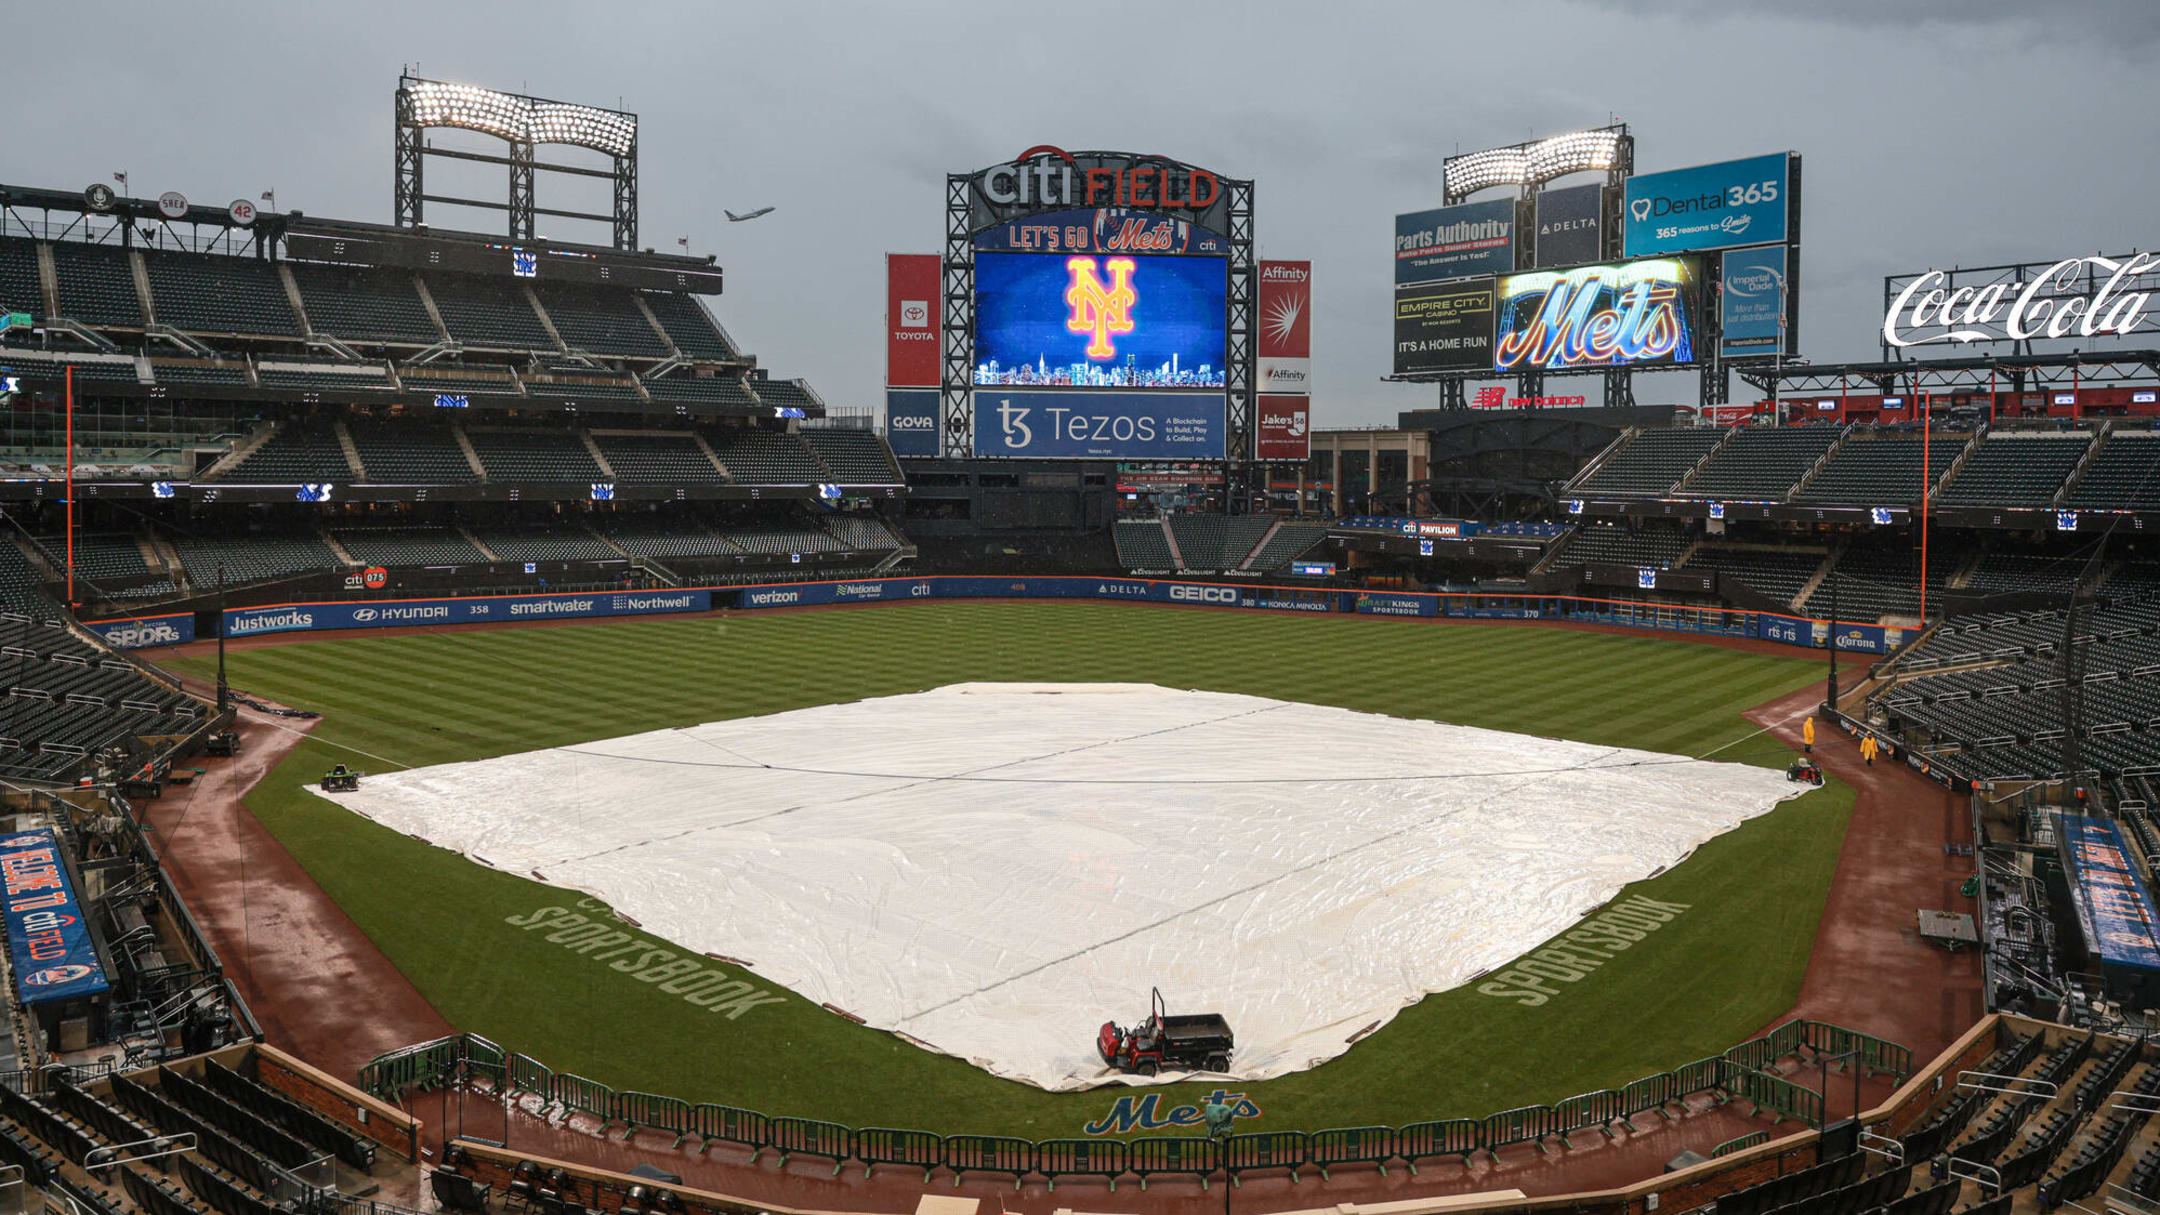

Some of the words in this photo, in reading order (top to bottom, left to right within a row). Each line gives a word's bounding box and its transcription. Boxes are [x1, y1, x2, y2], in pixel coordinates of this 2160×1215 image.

[984, 157, 1072, 206] citi
[1086, 167, 1219, 207] FIELD
[162, 200, 185, 209] SHEA
[234, 206, 251, 218] 42
[1553, 218, 1597, 233] DELTA
[1656, 227, 1677, 239] 365
[1679, 224, 1709, 234] reasons
[1010, 225, 1059, 248] LET'S
[1065, 226, 1088, 248] GO
[1107, 217, 1172, 249] Mets
[1396, 230, 1433, 251] Parts
[1436, 219, 1509, 245] Authority
[1199, 241, 1216, 250] citi
[1429, 255, 1459, 265] Answer
[1262, 266, 1308, 282] Affinity
[1733, 274, 1770, 285] Imperial
[1748, 282, 1773, 291] Dade
[1400, 301, 1450, 313] EMPIRE
[1454, 297, 1486, 308] CITY
[1884, 253, 2160, 347] Coca-Cola
[1426, 309, 1457, 318] CASINO
[1496, 276, 1679, 367] Mets
[895, 332, 934, 340] TOYOTA
[1398, 341, 1417, 353] IT'S
[1419, 341, 1427, 351] A
[1429, 338, 1461, 351] HOME
[1463, 336, 1487, 348] RUN
[1273, 370, 1306, 382] Affinity
[1508, 397, 1532, 407] new
[1534, 394, 1585, 407] balance
[893, 416, 934, 428] GOYA
[1046, 408, 1155, 441] Tezos
[1172, 417, 1207, 425] Blockchain
[1261, 414, 1293, 425] Jake's
[1193, 427, 1207, 435] Play
[1403, 522, 1416, 533] citi
[1420, 526, 1457, 535] PAVILION
[345, 574, 363, 585] citi
[367, 572, 384, 582] 075
[846, 584, 882, 596] National
[912, 583, 930, 596] citi
[1110, 584, 1147, 595] DELTA
[1169, 585, 1237, 602] GEICO
[628, 596, 690, 609] Northwell
[751, 591, 798, 604] verizon
[1242, 598, 1255, 607] 380
[470, 605, 489, 614] 358
[510, 599, 593, 615] smartwater
[1268, 601, 1295, 609] KONICA
[1296, 602, 1327, 610] MINOLTA
[382, 607, 448, 619] HYUNDAI
[1524, 610, 1539, 618] 370
[230, 611, 313, 631] Justworks
[1836, 635, 1876, 648] Corona
[0, 847, 63, 896] WELCOME
[9, 891, 68, 912] TO
[26, 928, 68, 961] FIELD
[1476, 894, 1693, 1007] SPORTSBOOK
[505, 906, 788, 1020] SPORTSBOOK
[1083, 1089, 1264, 1135] Mets
